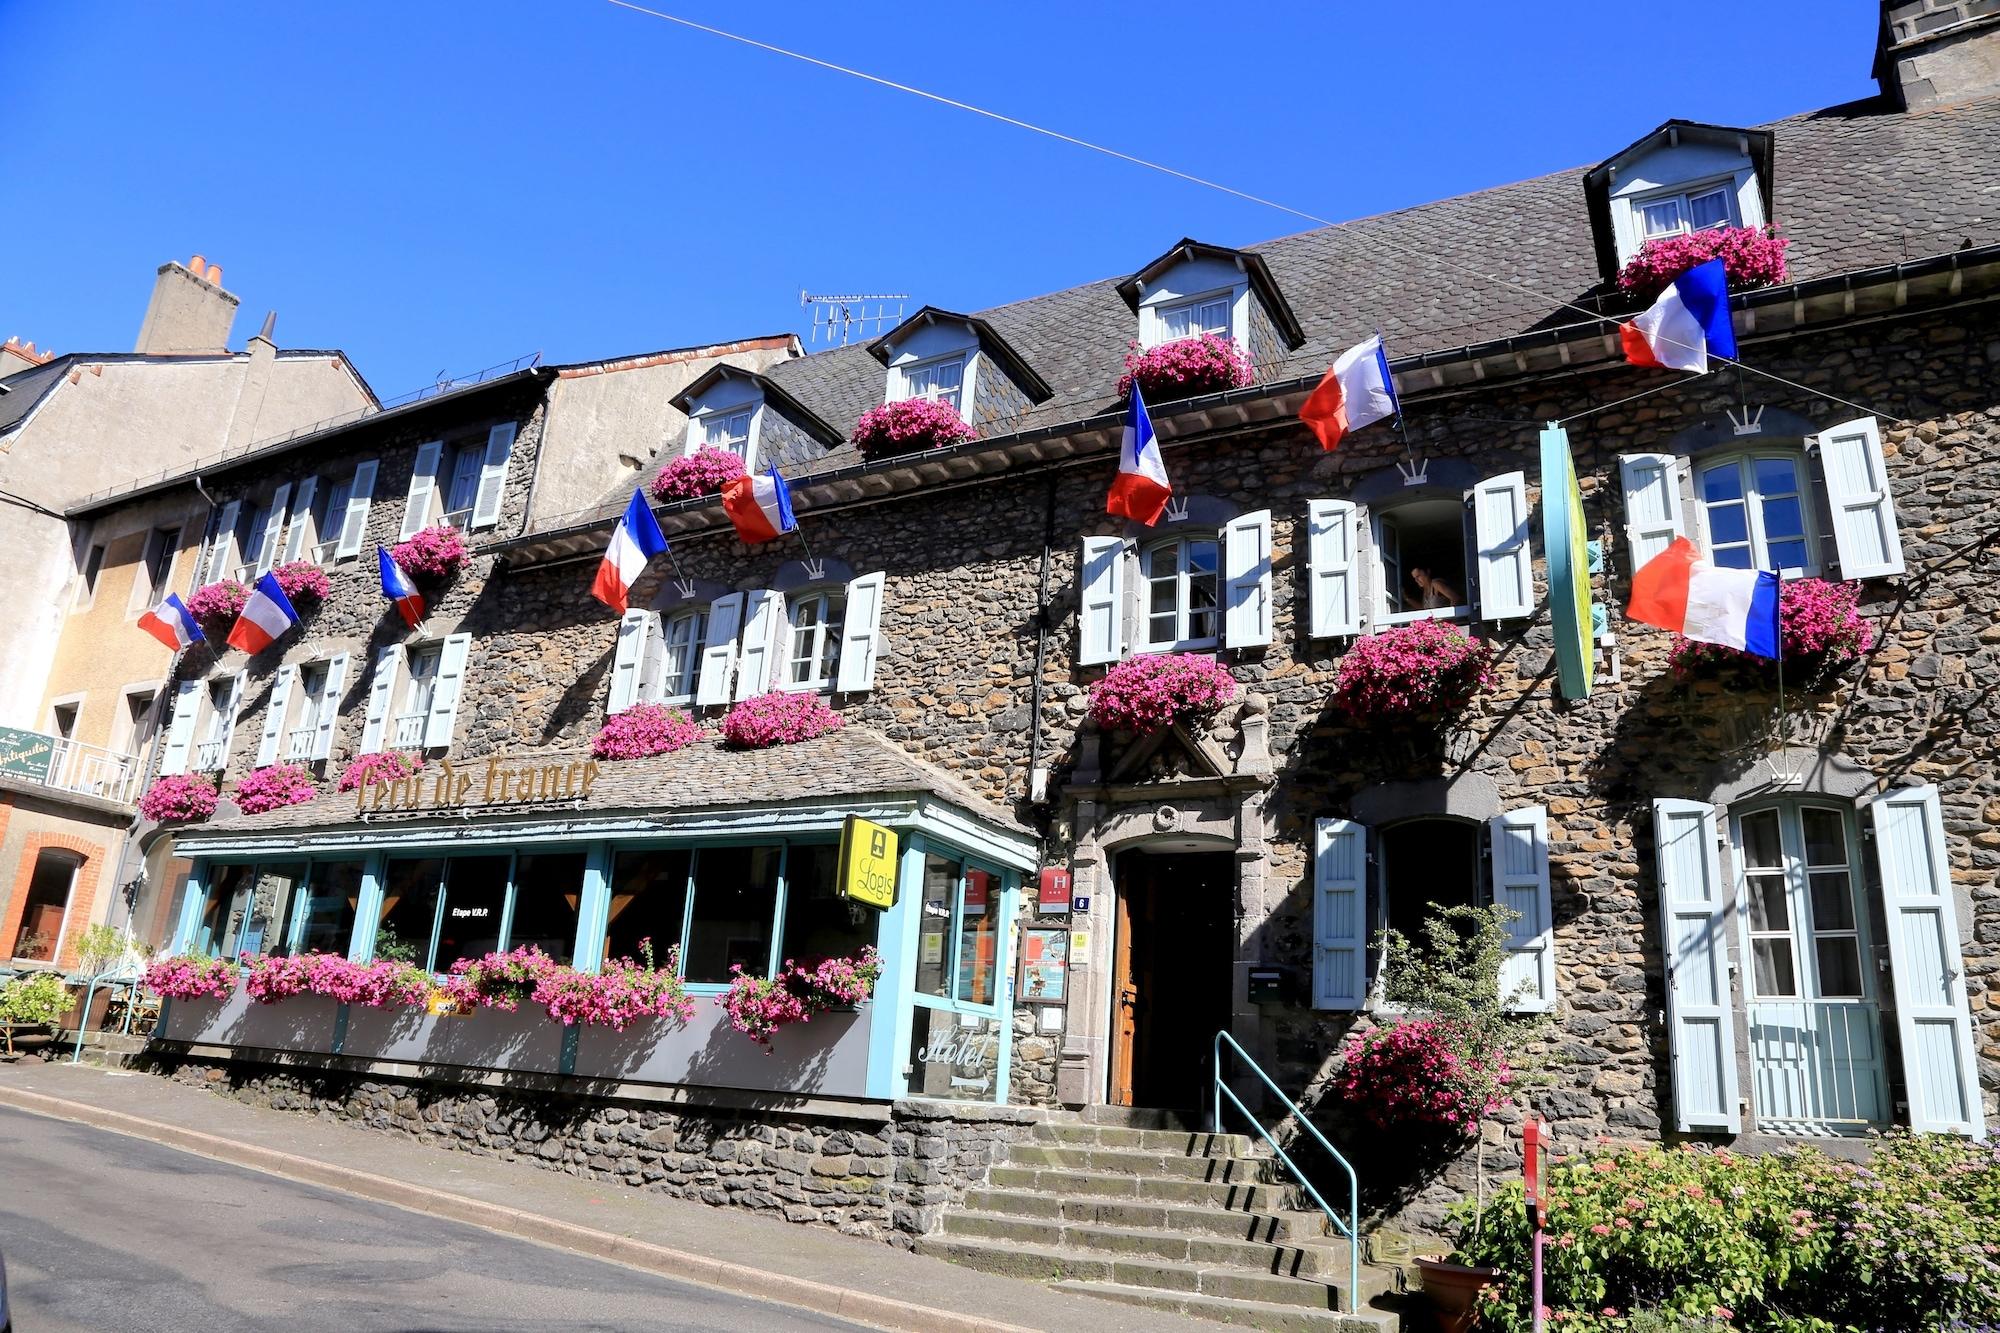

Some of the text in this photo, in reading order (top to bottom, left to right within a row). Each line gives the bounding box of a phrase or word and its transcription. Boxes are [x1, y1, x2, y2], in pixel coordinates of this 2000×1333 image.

[433, 758, 474, 806] de
[483, 756, 601, 805] france
[857, 857, 893, 900] Logis
[1053, 875, 1067, 889] H
[1079, 898, 1085, 909] 6
